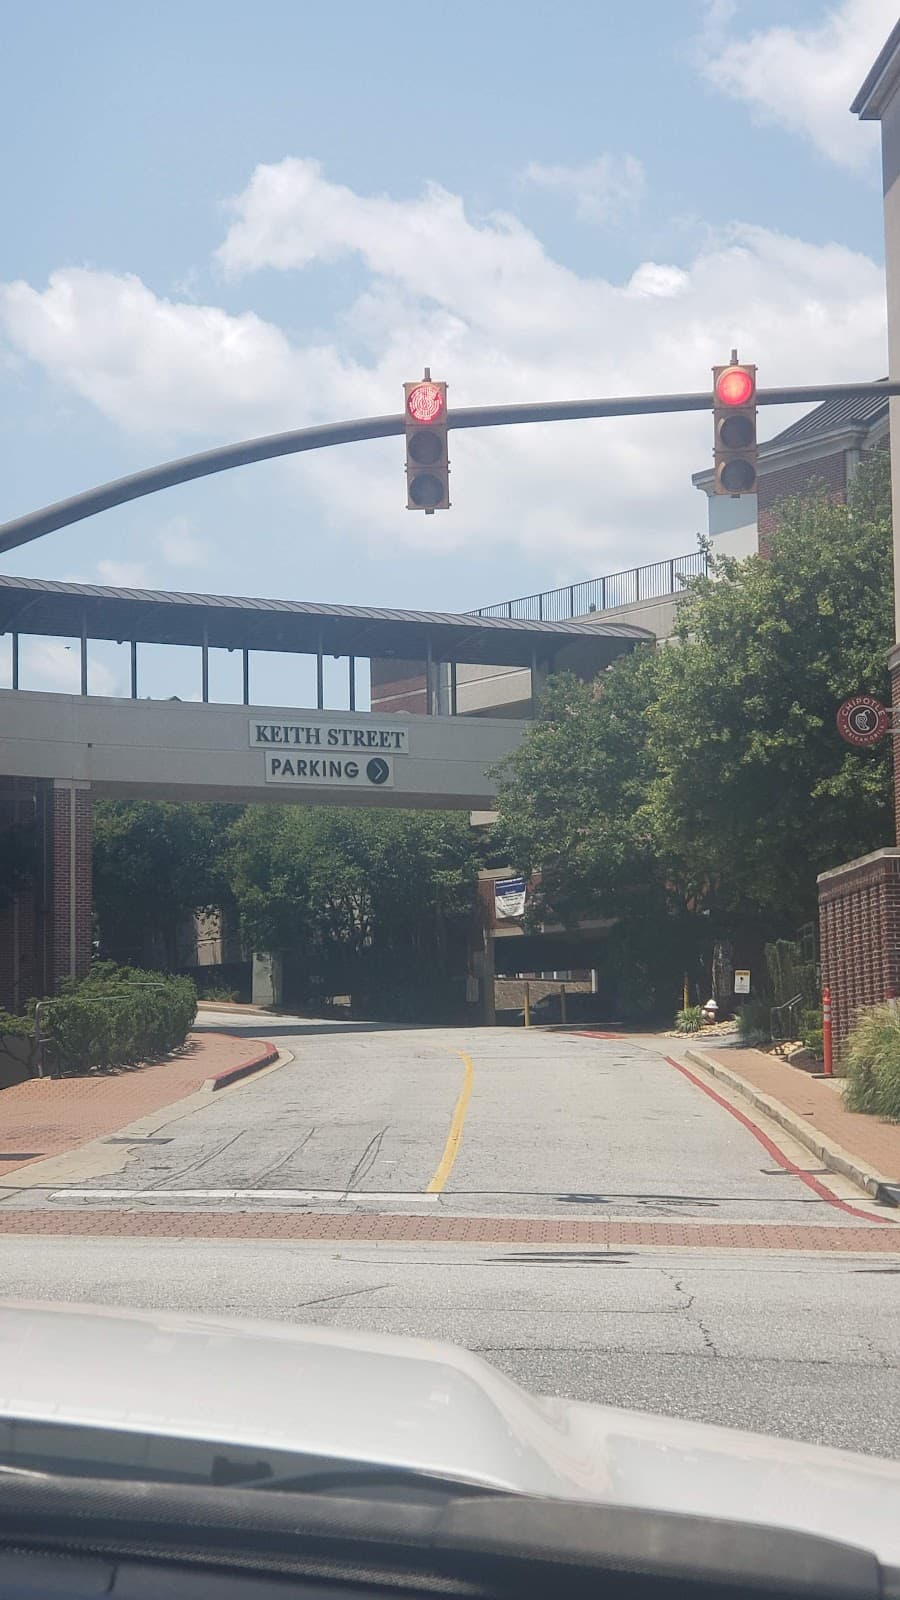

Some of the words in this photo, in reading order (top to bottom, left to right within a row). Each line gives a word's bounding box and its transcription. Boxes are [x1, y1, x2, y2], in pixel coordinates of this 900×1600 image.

[842, 698, 886, 716] CHIPOTLE
[256, 725, 321, 745] KEITH
[327, 728, 405, 749] STREET
[271, 758, 359, 778] PARKING
